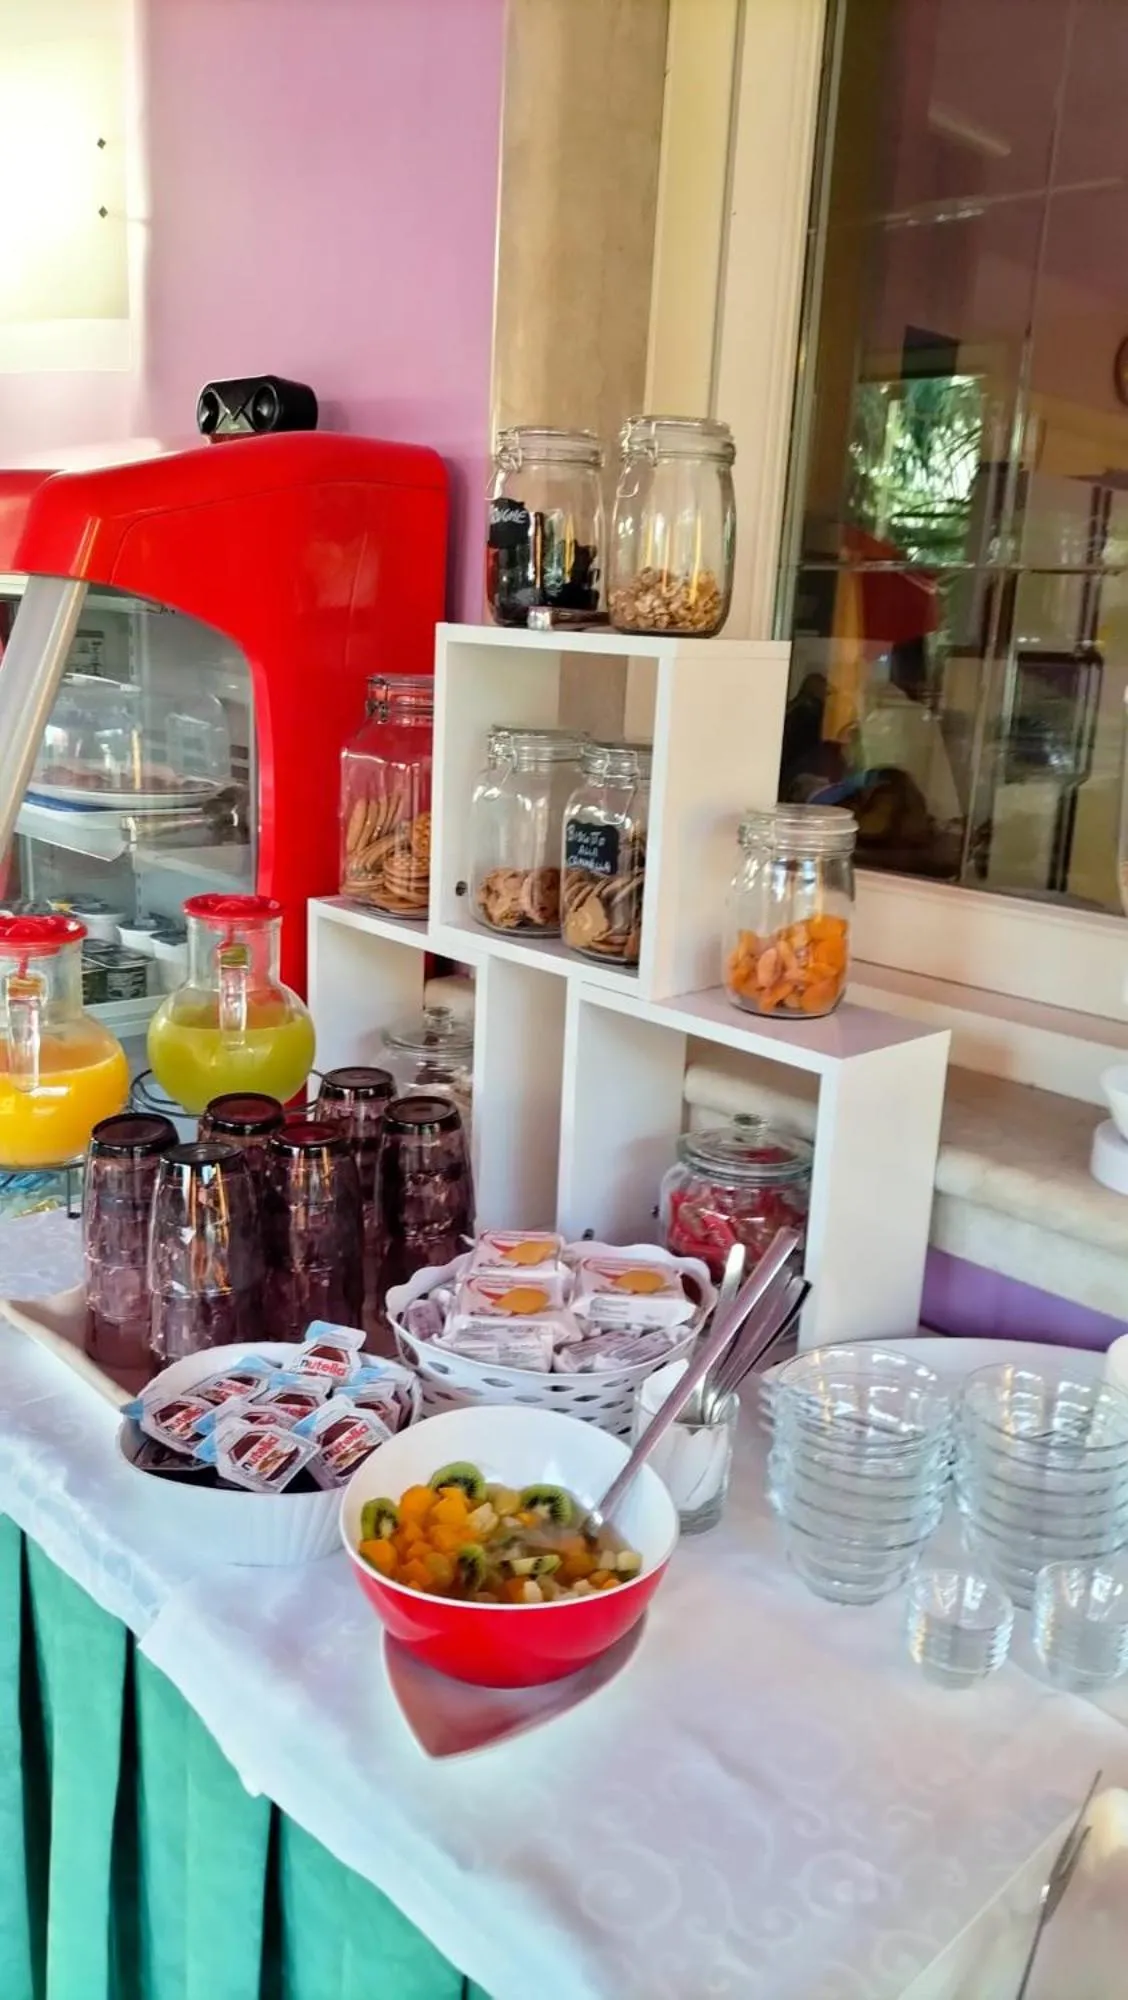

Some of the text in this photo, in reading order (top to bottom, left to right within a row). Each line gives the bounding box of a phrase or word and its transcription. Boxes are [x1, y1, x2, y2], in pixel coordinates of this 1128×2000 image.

[301, 1359, 346, 1377] nutella
[241, 1435, 280, 1471] nutella
[322, 1424, 369, 1461] nutella
